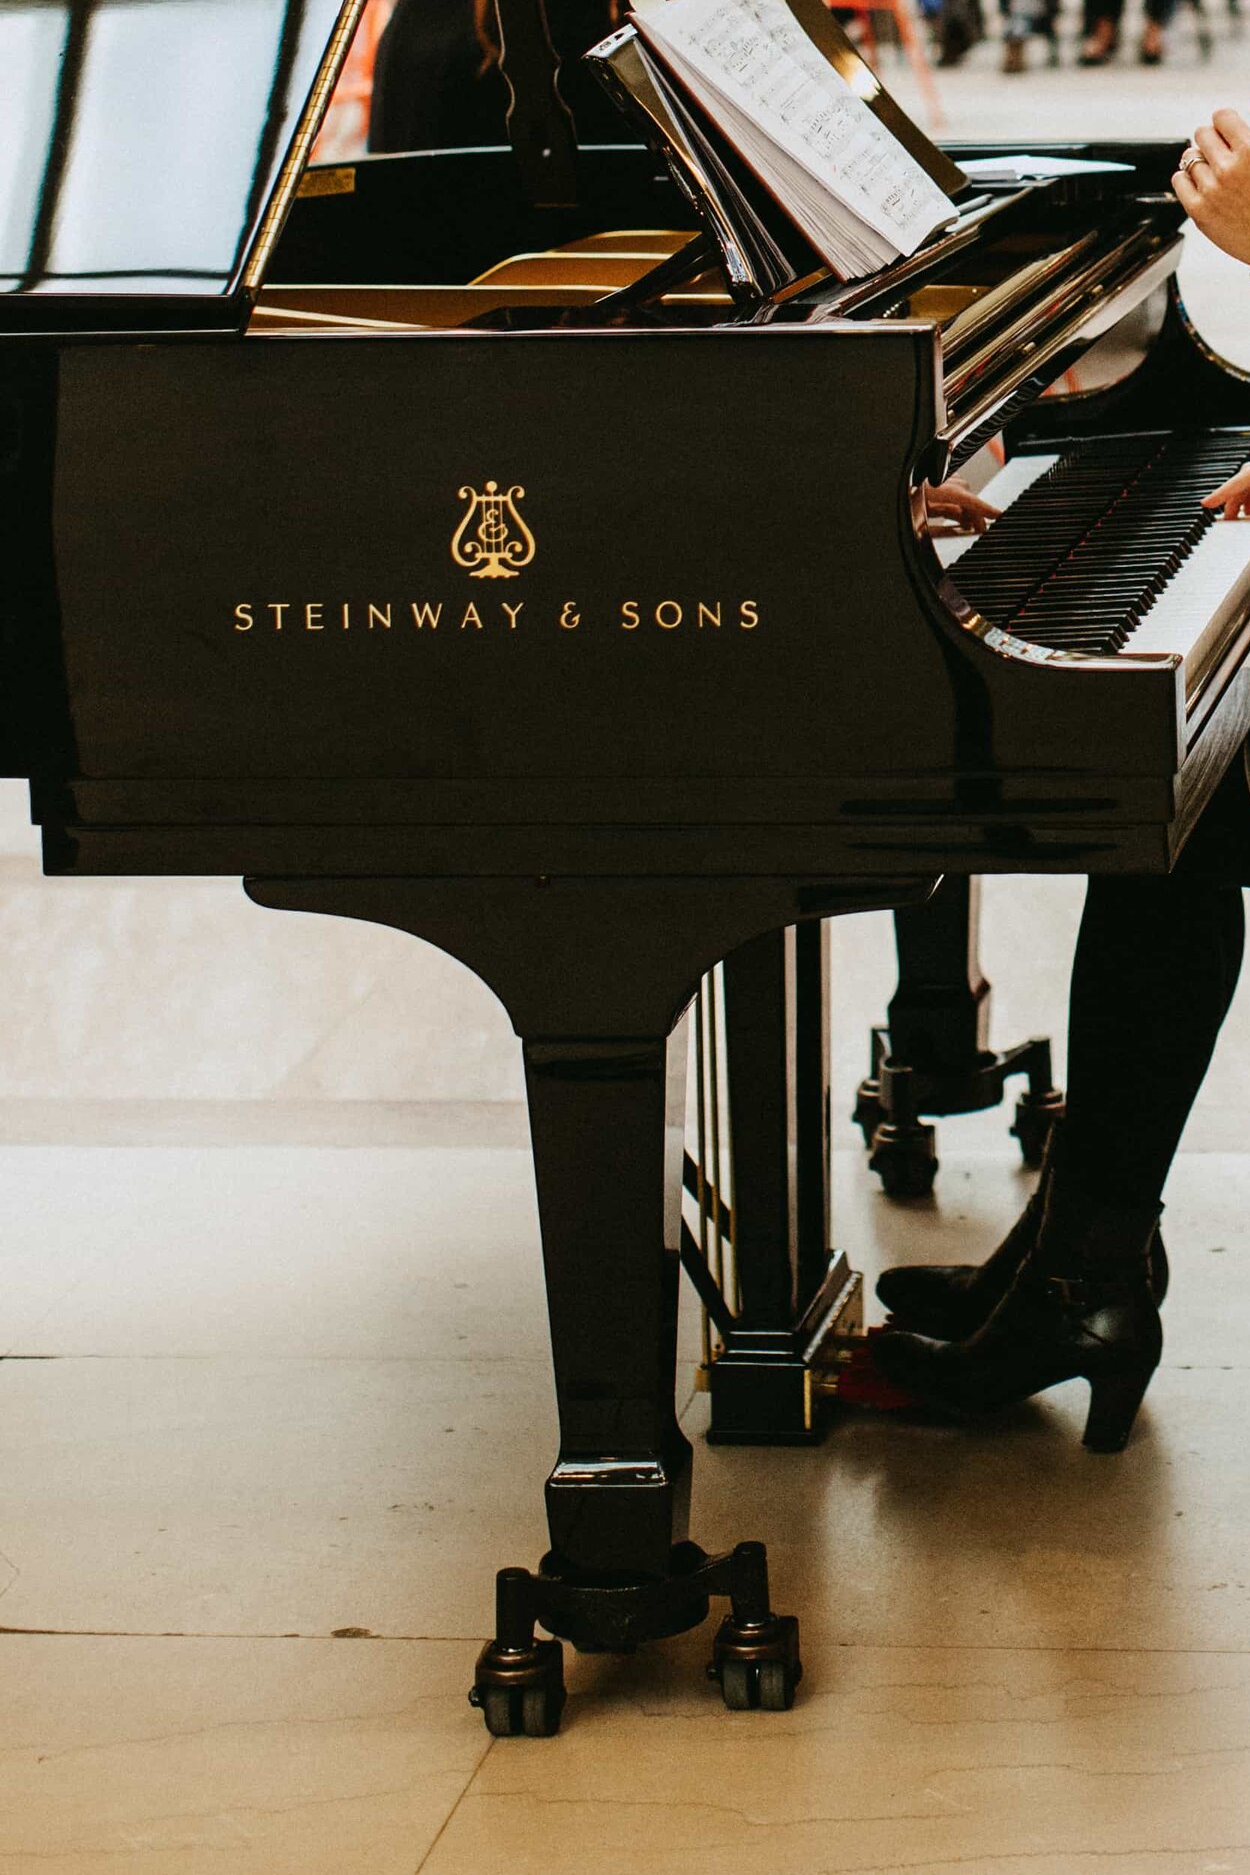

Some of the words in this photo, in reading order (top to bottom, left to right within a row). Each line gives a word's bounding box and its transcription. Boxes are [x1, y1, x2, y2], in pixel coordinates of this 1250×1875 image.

[234, 601, 524, 631] STEINWAY
[559, 601, 581, 629] &
[621, 600, 760, 630] SONS
